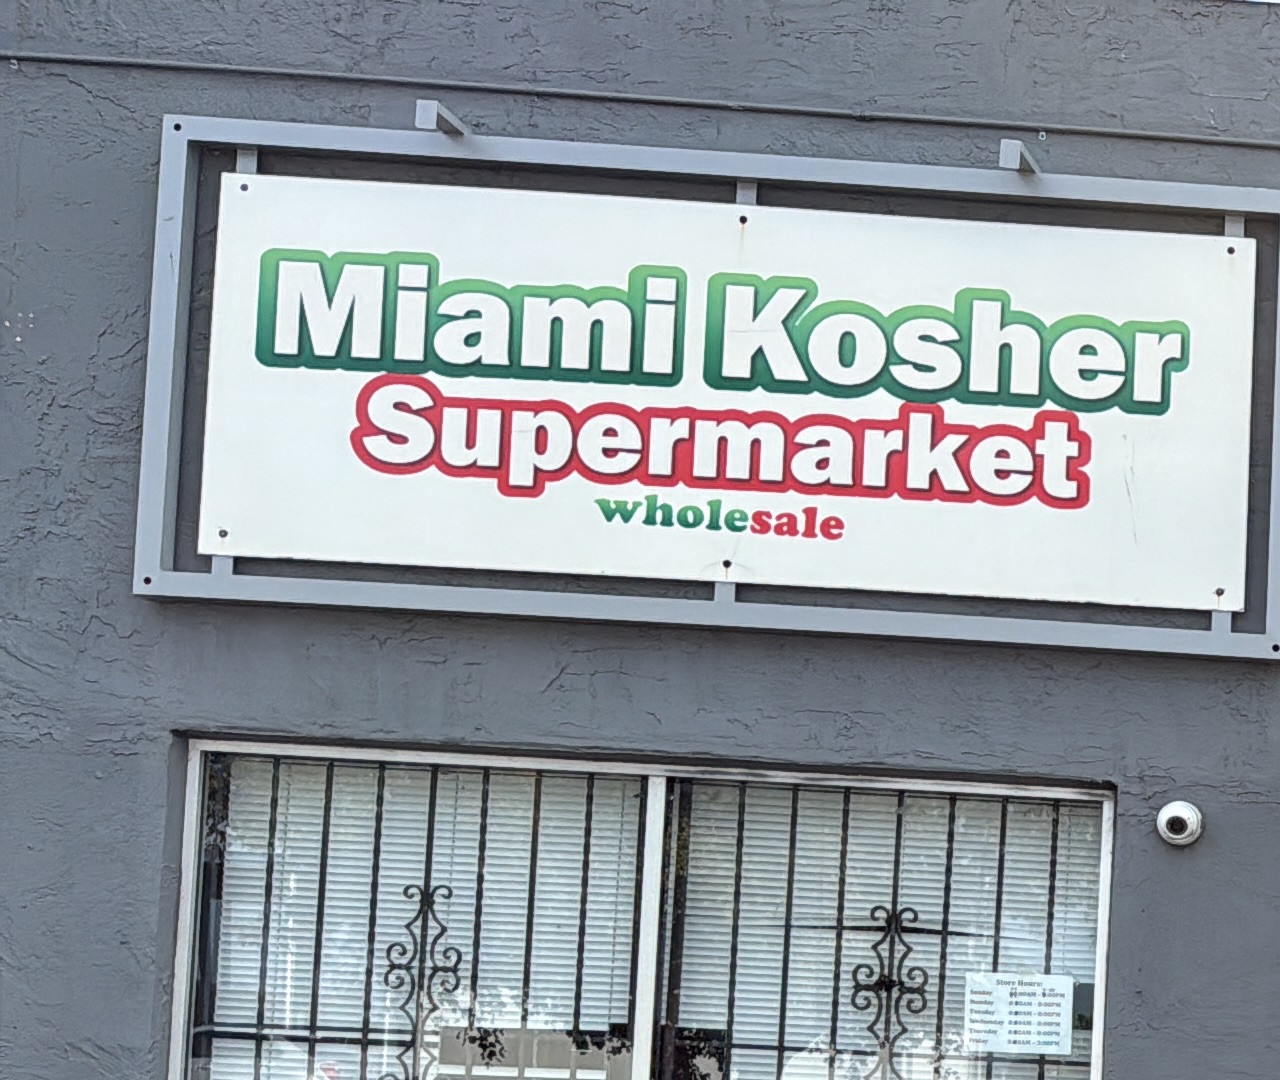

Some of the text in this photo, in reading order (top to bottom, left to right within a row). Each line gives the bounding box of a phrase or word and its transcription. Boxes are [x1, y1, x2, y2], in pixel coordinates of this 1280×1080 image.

[262, 254, 1186, 408] Miami Kosher
[356, 377, 1086, 504] Supermarket
[594, 496, 845, 541] wholesale
